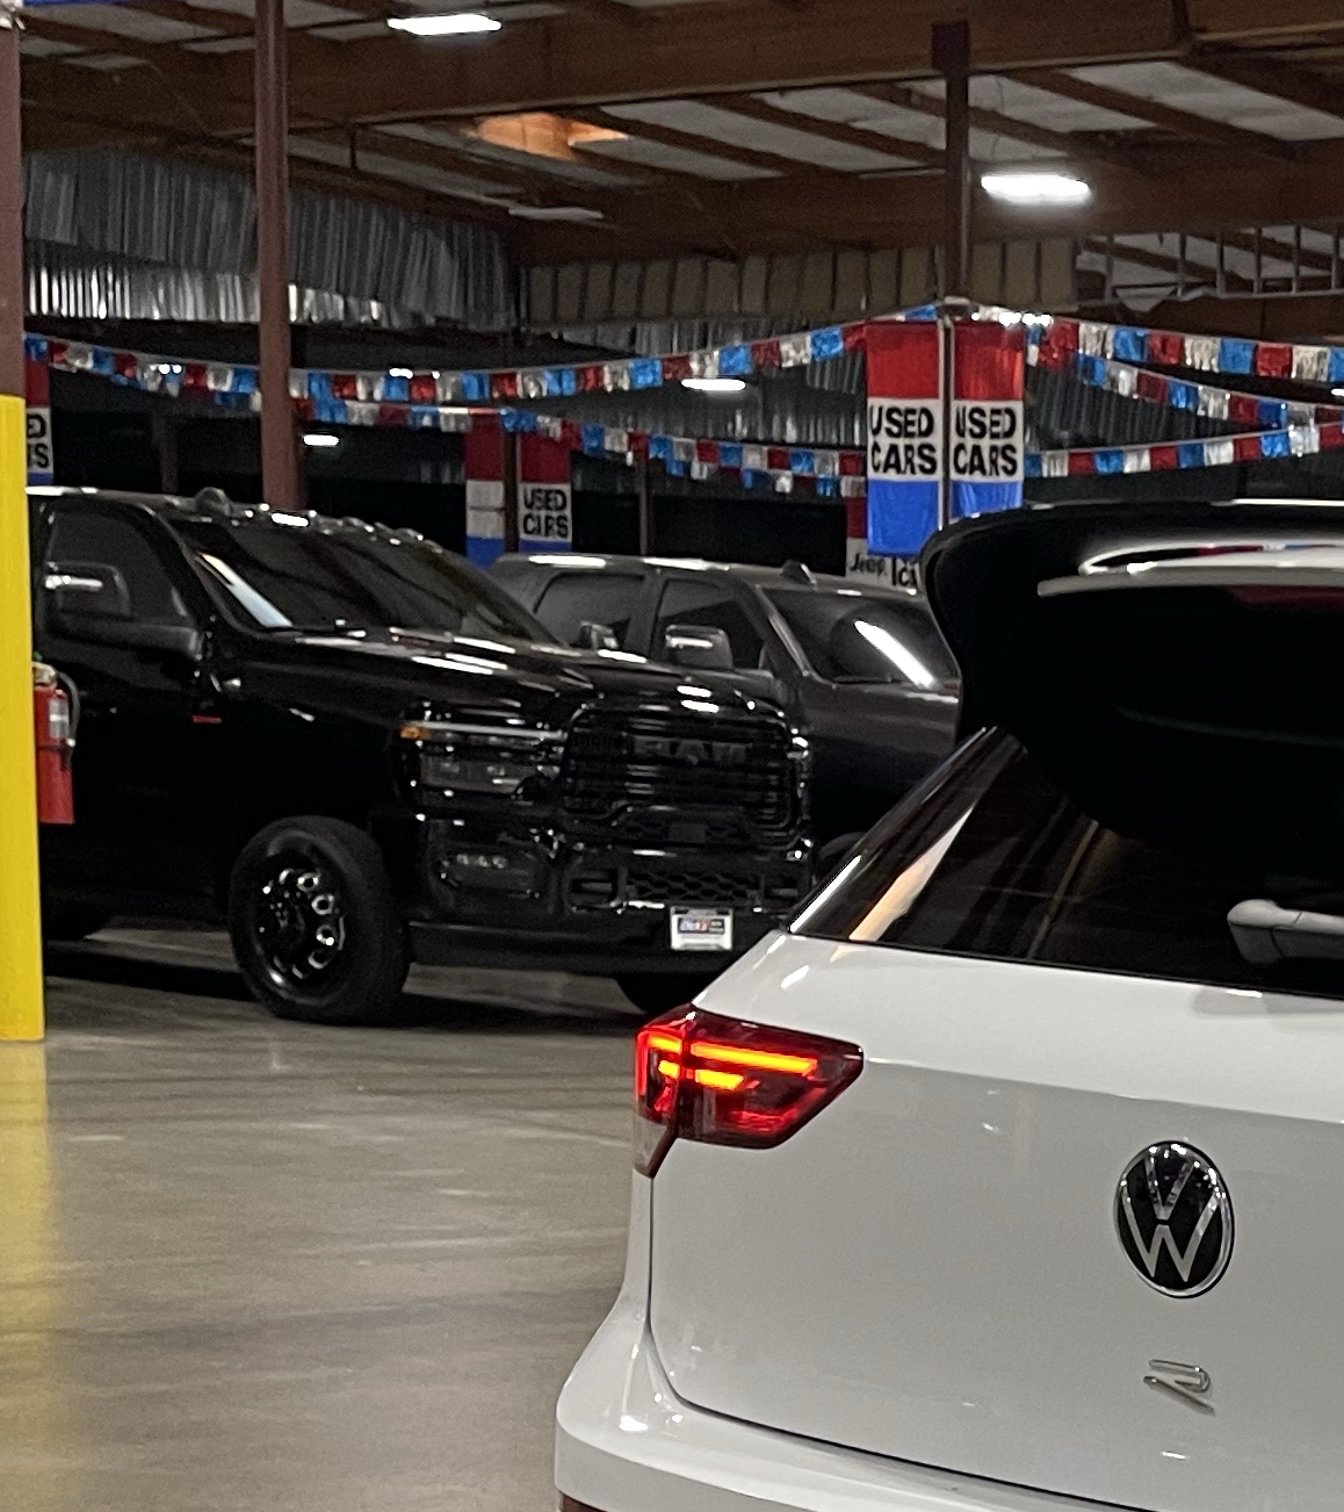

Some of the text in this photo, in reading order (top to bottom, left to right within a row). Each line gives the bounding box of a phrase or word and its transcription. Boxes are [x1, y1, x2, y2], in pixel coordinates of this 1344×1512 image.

[869, 404, 934, 438] USED
[955, 406, 1017, 440] USED
[870, 443, 937, 475] CARS
[953, 443, 1018, 476] CARS
[523, 488, 567, 511] USED
